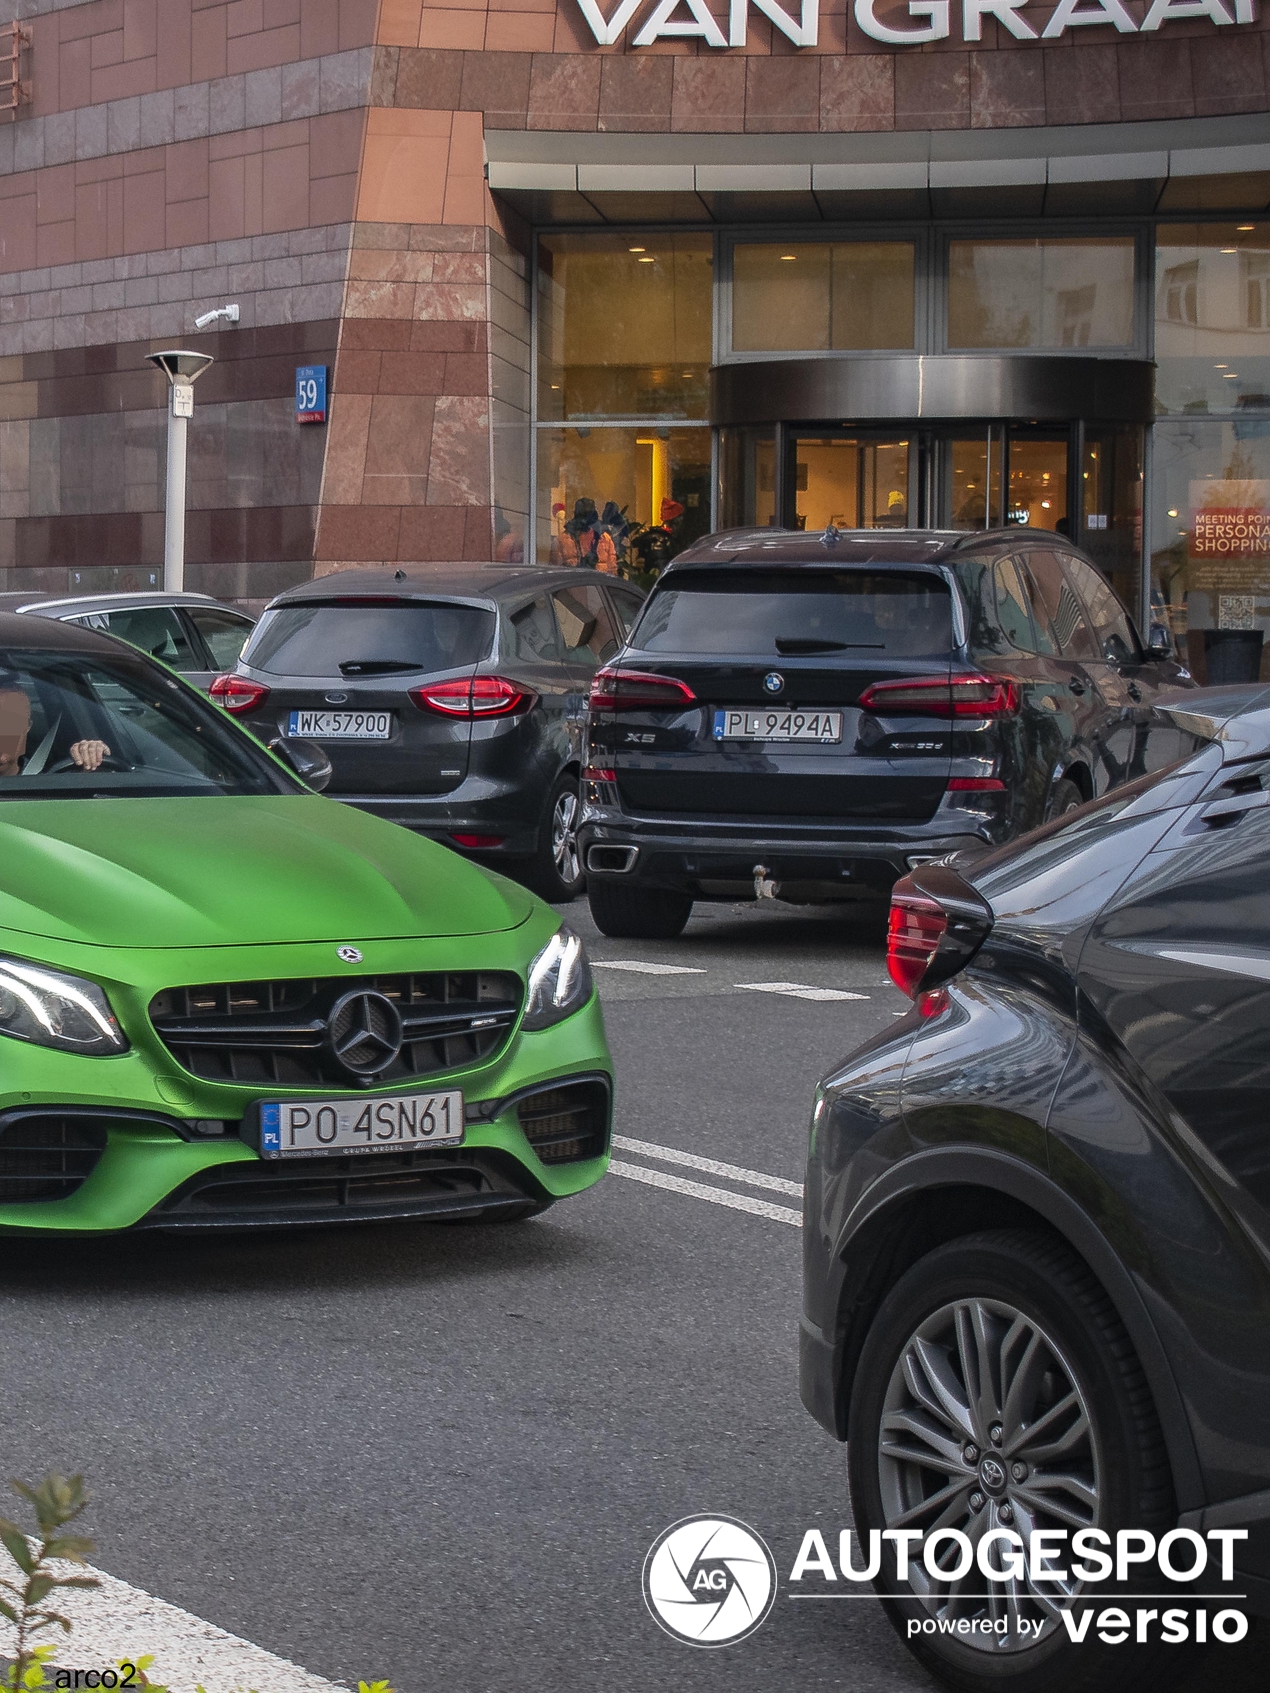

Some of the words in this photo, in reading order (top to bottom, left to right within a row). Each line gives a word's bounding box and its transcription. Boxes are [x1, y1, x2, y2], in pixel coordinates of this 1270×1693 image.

[574, 0, 819, 47] VAN
[298, 379, 317, 410] 59
[1195, 515, 1244, 524] MEETING
[1195, 539, 1270, 552] SHOPPIN
[301, 713, 326, 732] WK
[332, 713, 387, 732] 57900
[728, 713, 755, 735] PL
[765, 713, 833, 736] 9494A
[624, 732, 656, 743] X5
[264, 1133, 279, 1144] PL
[288, 1105, 338, 1146] PO
[353, 1096, 451, 1141] 4SN61
